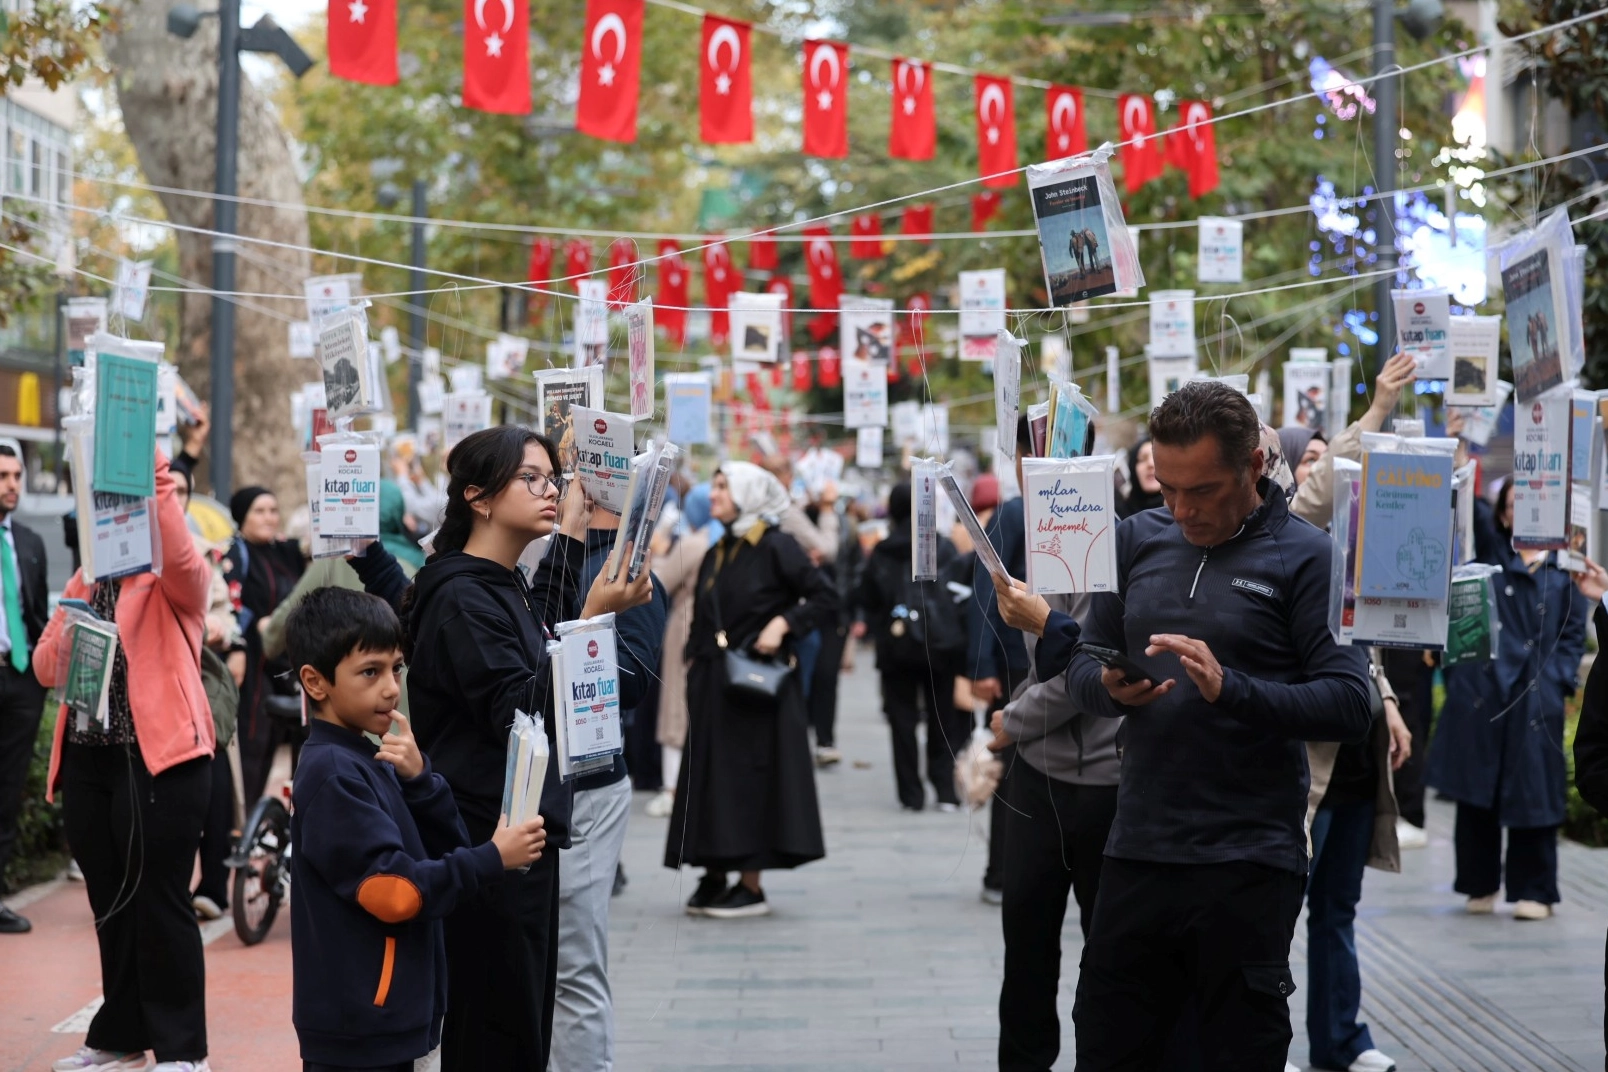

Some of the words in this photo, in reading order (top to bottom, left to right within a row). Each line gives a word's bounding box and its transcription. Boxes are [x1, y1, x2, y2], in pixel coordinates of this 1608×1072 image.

[1045, 192, 1058, 200] John
[1059, 184, 1088, 197] Steinbeck
[577, 446, 602, 468] kitap
[603, 451, 630, 471] fuarı
[1514, 449, 1537, 475] kitap
[324, 478, 350, 496] kitap
[351, 478, 376, 493] fuarı
[1038, 479, 1078, 500] milan
[1376, 488, 1419, 500] Görünmez
[1049, 496, 1103, 518] kundera
[1375, 500, 1406, 510] Kentler
[1037, 517, 1093, 536] bilmemek
[571, 681, 597, 702] kitap
